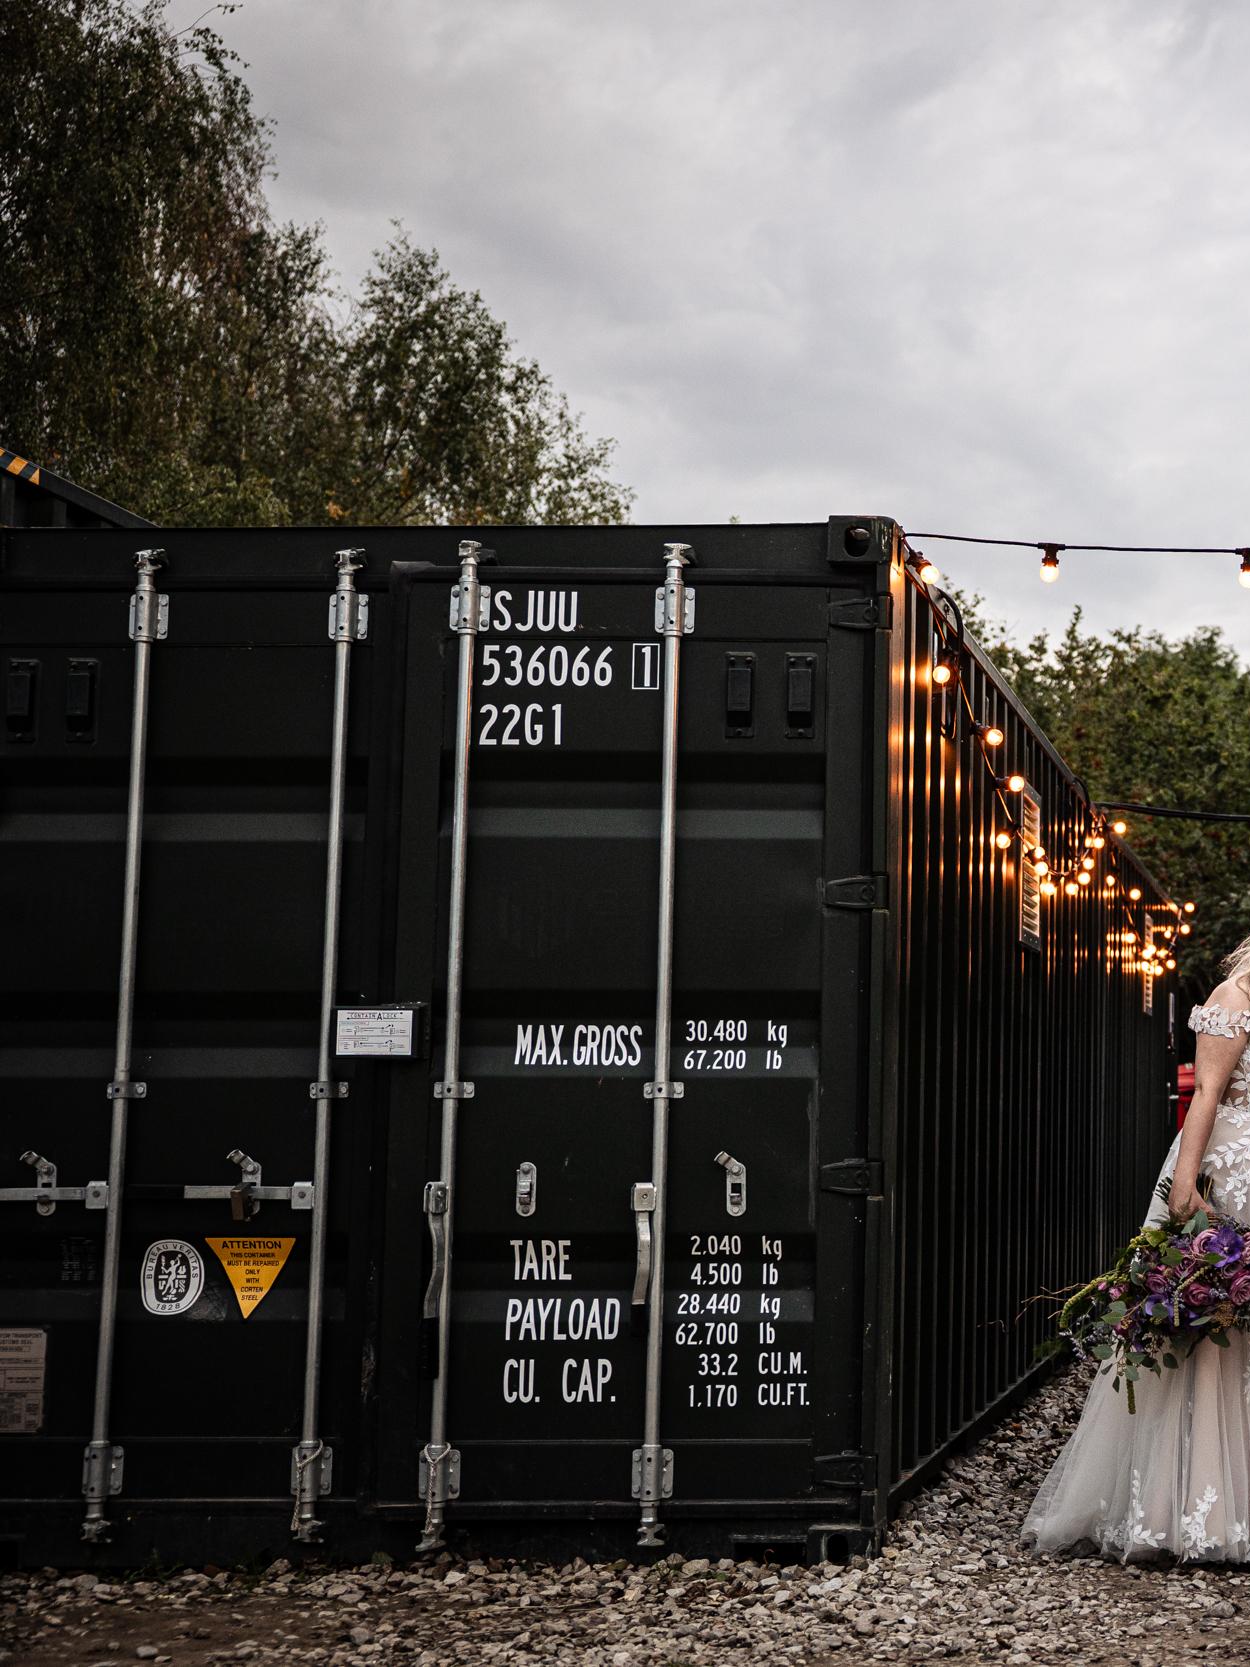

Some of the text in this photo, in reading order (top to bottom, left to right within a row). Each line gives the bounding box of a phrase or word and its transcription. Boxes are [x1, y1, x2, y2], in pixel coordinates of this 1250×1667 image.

[493, 591, 577, 632] SJUU
[482, 645, 651, 687] 536066 1
[479, 703, 561, 745] 22G1
[686, 1020, 787, 1048] 30,480 kg
[684, 1050, 782, 1069] 67,200 lb
[221, 1240, 282, 1250] ATTENTION
[691, 1236, 781, 1260] 2,040 kg
[146, 1243, 169, 1279] BUREAU
[172, 1243, 199, 1279] VERITAS
[510, 1240, 572, 1280] TARE
[691, 1263, 778, 1285] 4,500 lb
[506, 1298, 620, 1340] PAYLOAD
[678, 1293, 780, 1320] 28,440 kg
[676, 1322, 775, 1345] 62,700 lb
[698, 1354, 737, 1375] 33.2
[504, 1359, 615, 1403] CU. CAP.
[689, 1385, 737, 1407] 1,170
